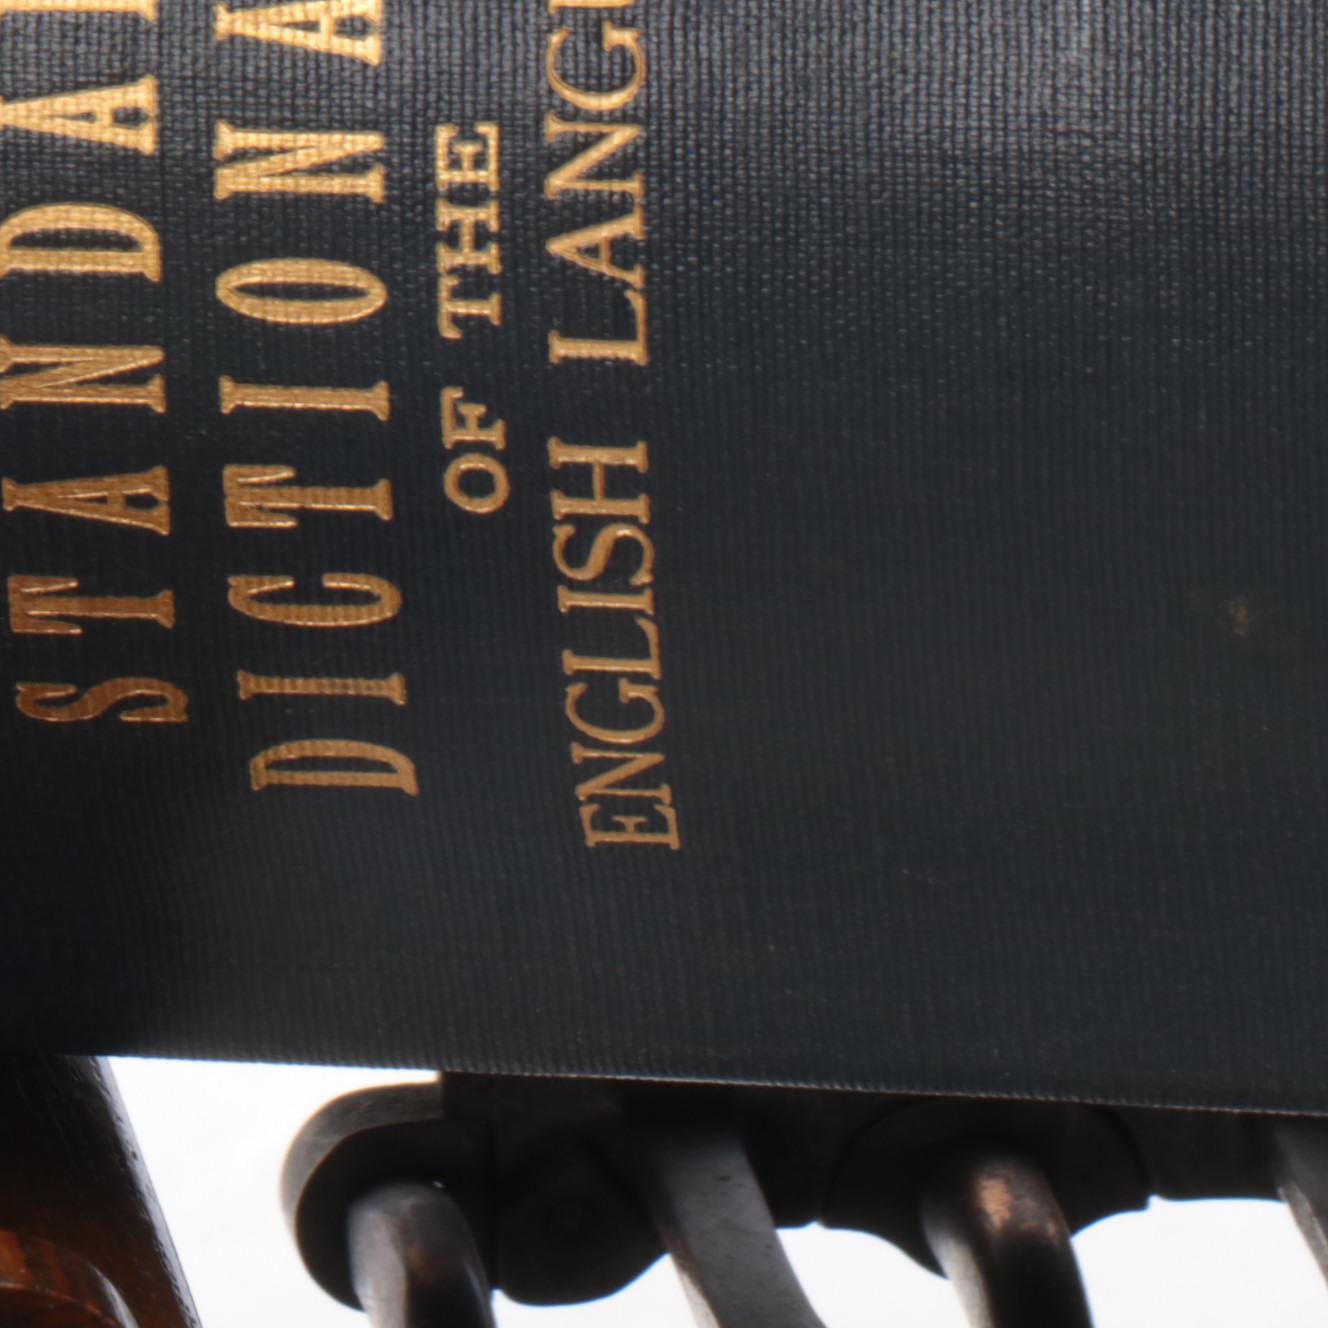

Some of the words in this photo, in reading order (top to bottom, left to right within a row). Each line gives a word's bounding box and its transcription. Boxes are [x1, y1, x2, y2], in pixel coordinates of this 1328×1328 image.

[434, 121, 503, 341] THE
[441, 387, 512, 516] OF
[547, 437, 682, 851] ENGLISH
